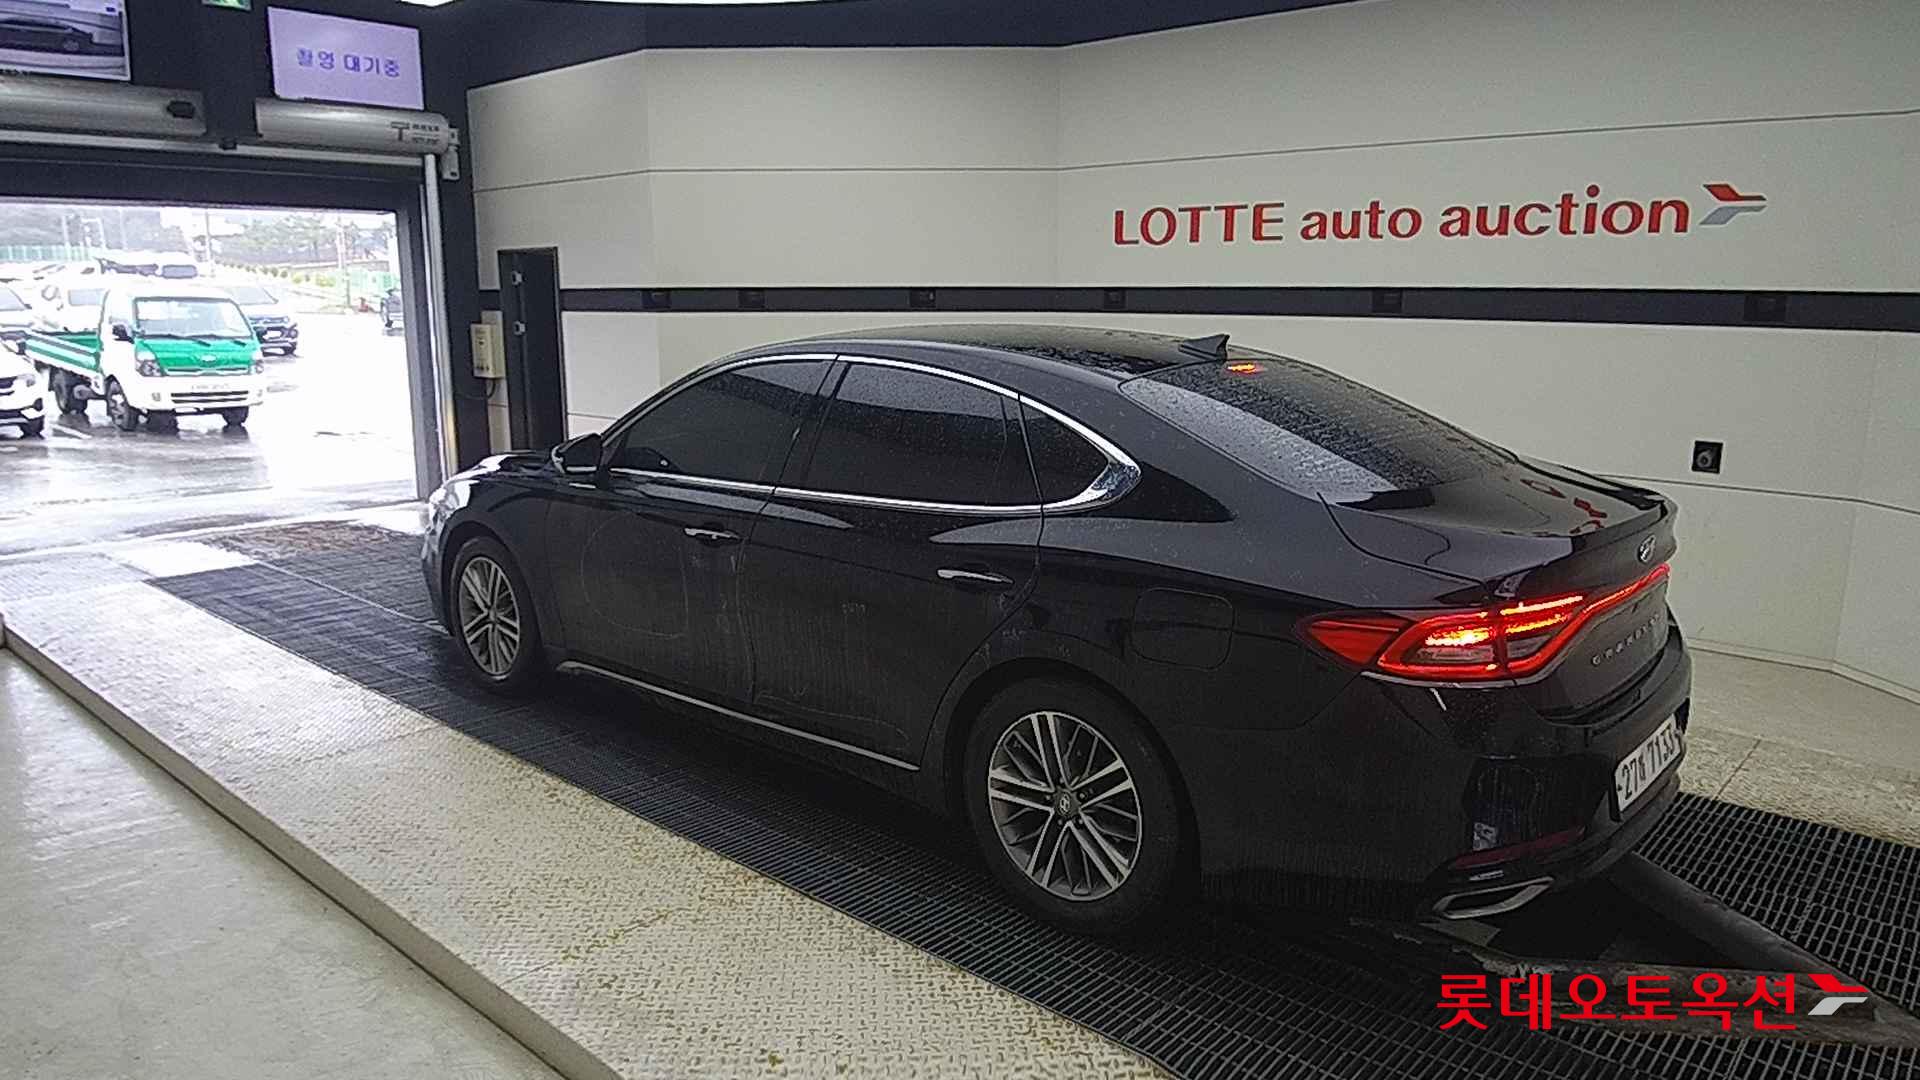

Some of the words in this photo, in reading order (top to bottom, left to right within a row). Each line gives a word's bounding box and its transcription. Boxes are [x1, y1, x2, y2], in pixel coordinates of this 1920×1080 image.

[343, 54, 400, 78] 대기중
[1114, 202, 1285, 246] LOTTE
[1300, 200, 1422, 240] auto
[1439, 184, 1689, 237] auction
